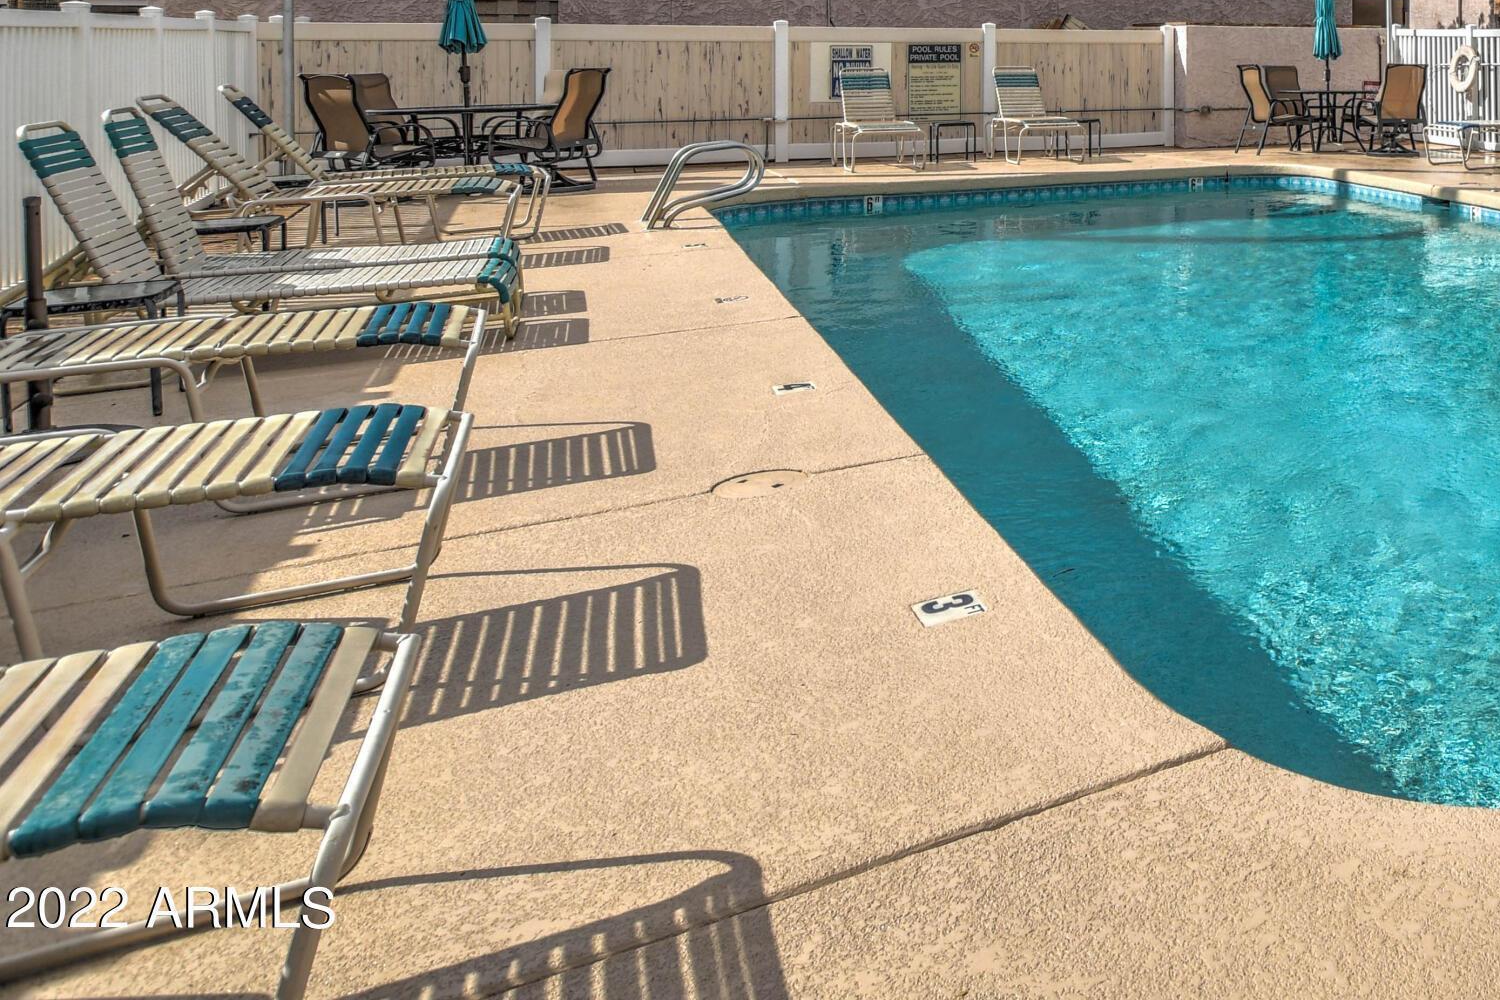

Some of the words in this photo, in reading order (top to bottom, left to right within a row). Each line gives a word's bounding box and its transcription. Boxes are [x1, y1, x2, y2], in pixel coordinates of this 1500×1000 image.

[832, 47, 853, 59] SHALLOW
[856, 47, 871, 59] WATER
[921, 594, 974, 614] 3
